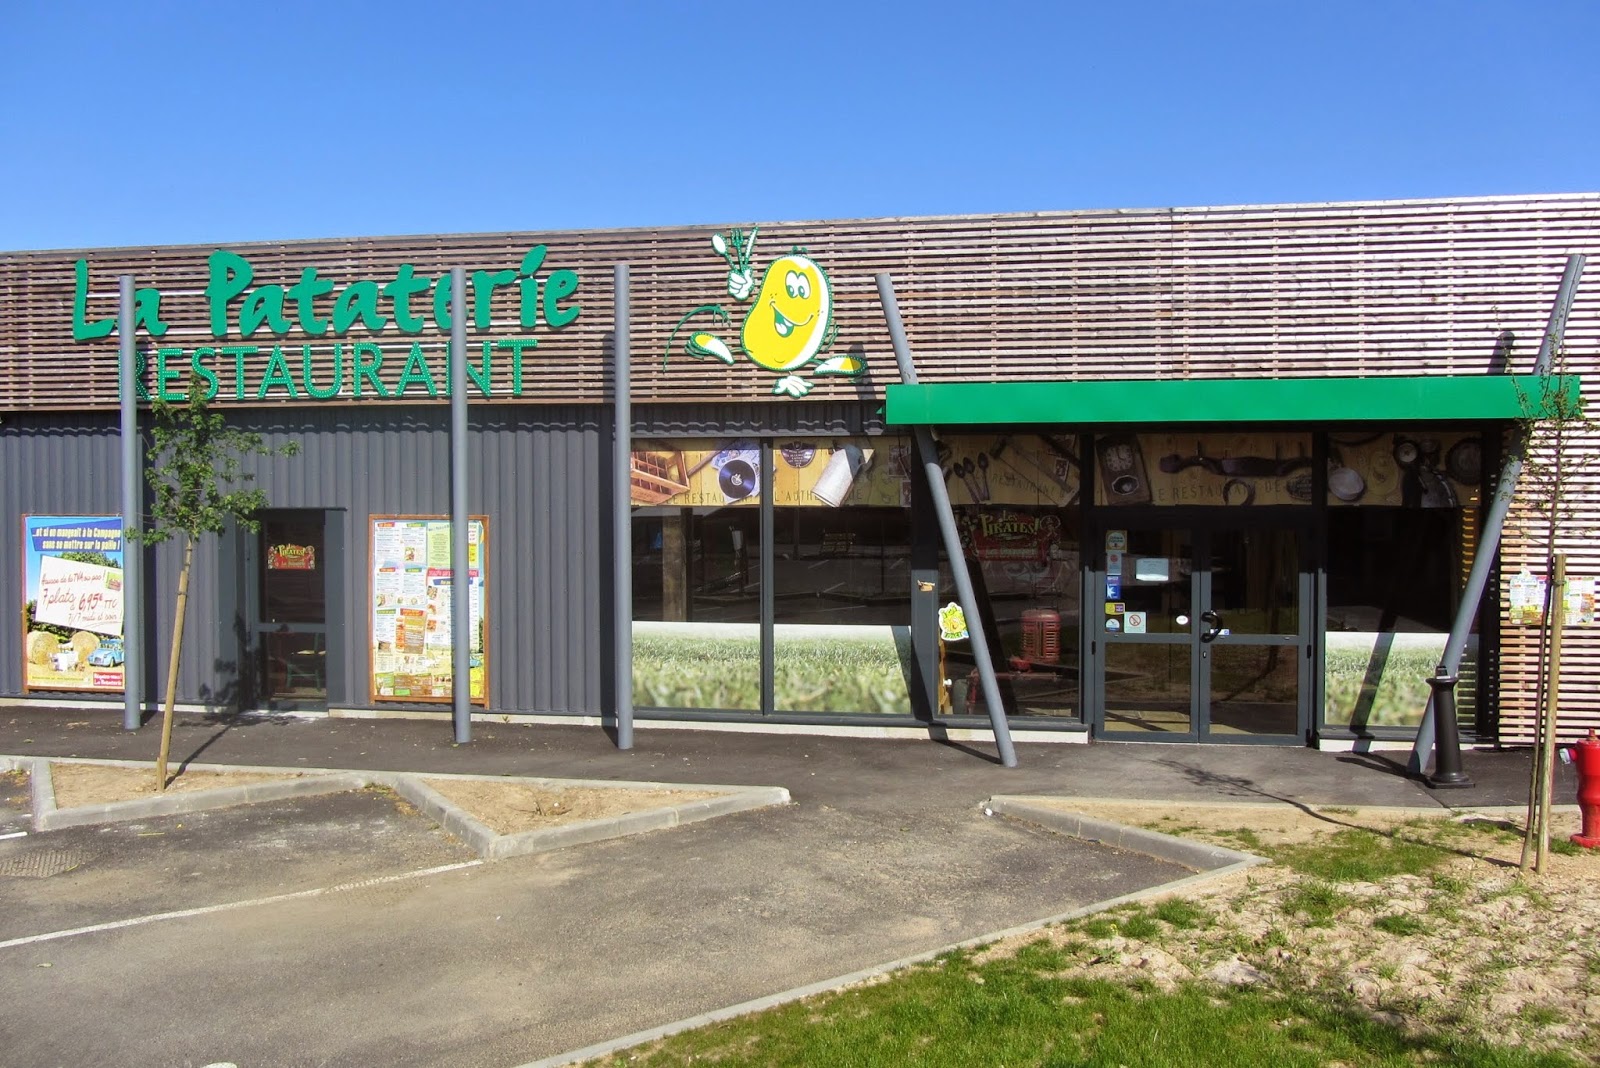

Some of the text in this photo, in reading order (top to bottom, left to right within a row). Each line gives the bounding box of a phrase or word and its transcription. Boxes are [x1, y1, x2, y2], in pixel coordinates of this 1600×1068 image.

[72, 244, 581, 341] La Pataterie
[43, 587, 76, 610] 7 plats
